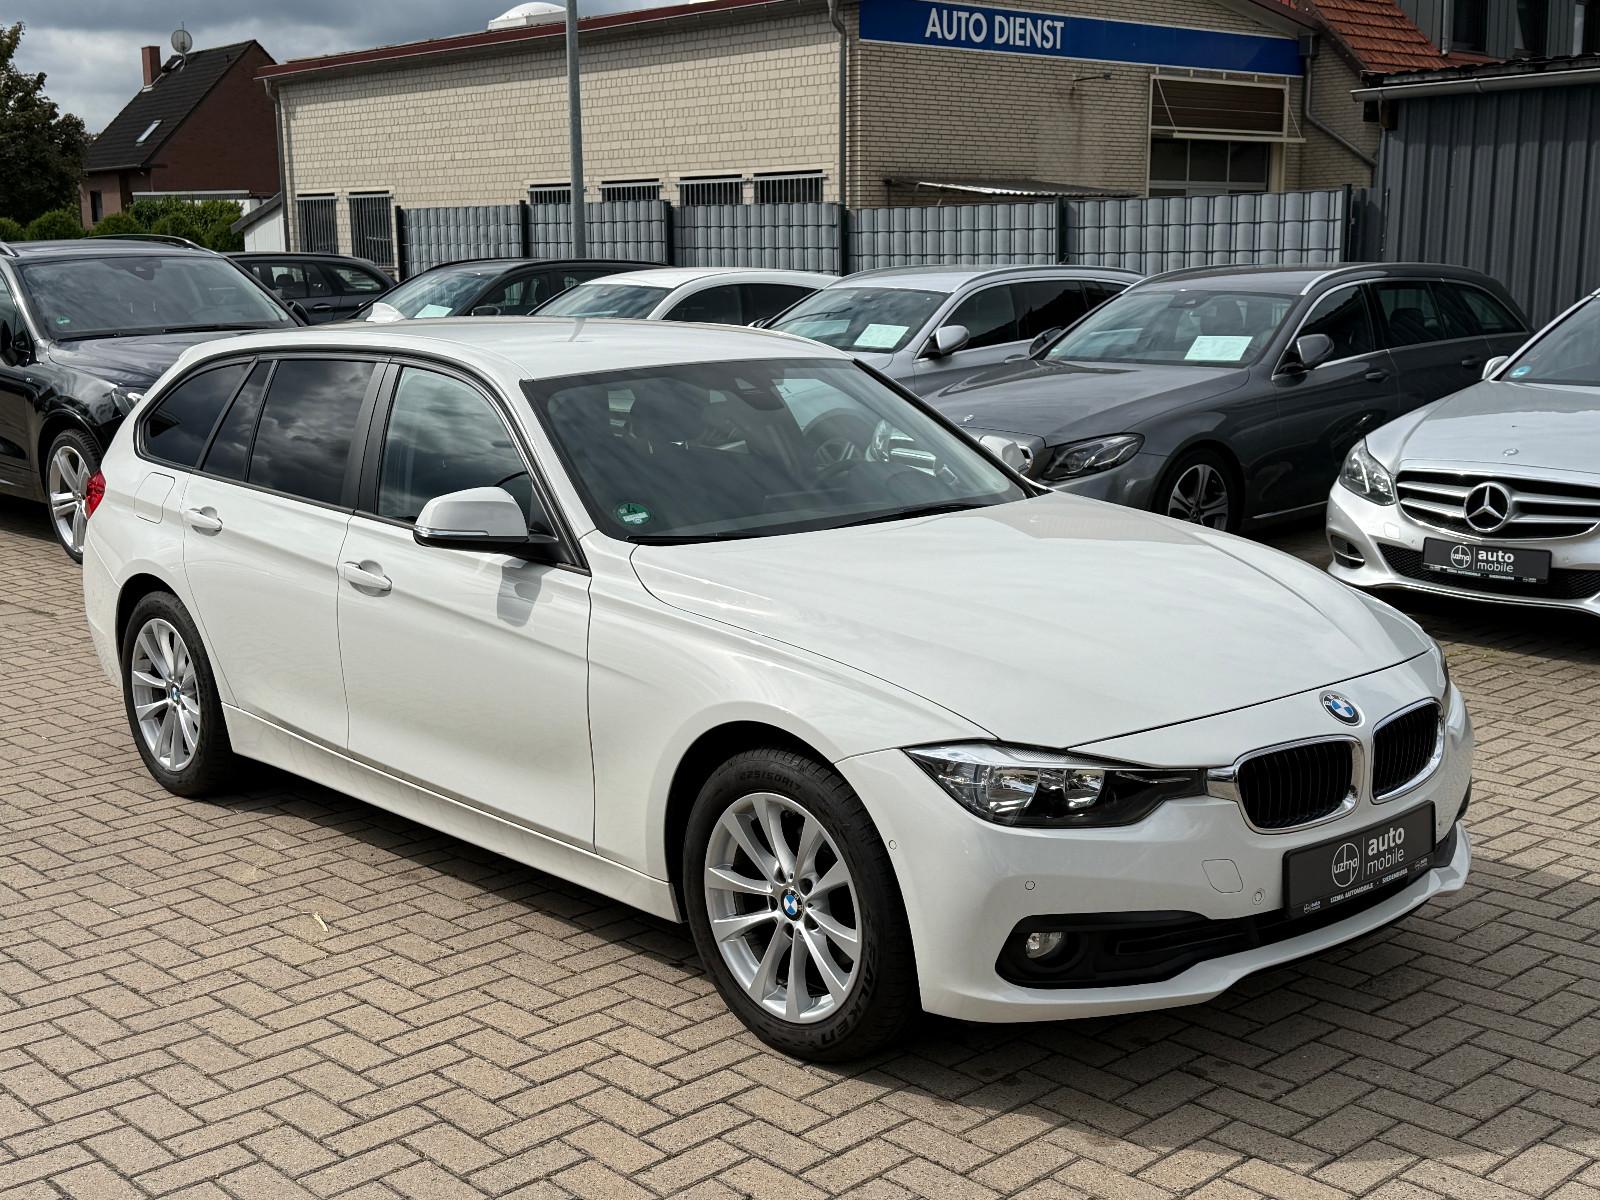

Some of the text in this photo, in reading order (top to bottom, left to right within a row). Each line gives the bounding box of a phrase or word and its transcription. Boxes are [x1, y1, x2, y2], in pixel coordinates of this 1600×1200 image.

[925, 7, 1065, 50] AUTO DIENST
[1477, 550, 1515, 563] auto
[1477, 562, 1514, 573] mobile
[1367, 827, 1405, 856] auto
[1367, 847, 1404, 875] mobile
